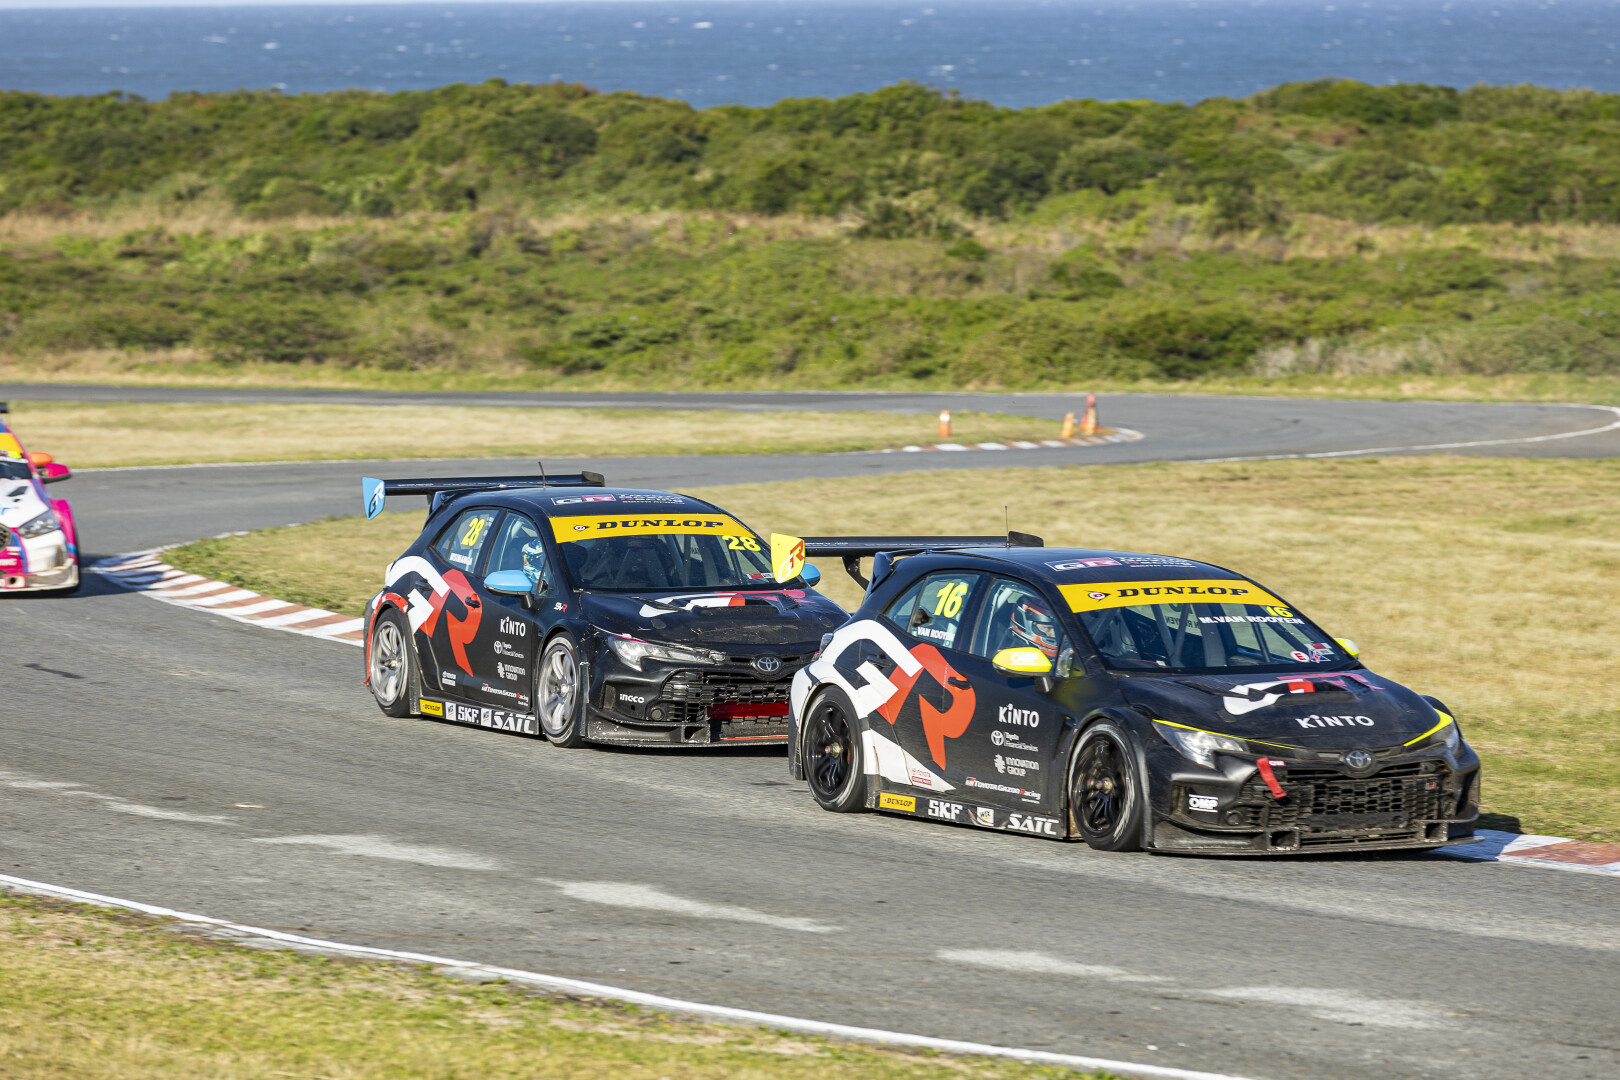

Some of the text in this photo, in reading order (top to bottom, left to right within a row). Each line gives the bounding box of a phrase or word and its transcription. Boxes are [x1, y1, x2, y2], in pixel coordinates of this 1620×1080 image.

[553, 495, 615, 505] GR
[597, 519, 724, 530] DUNLOP
[460, 517, 486, 547] 28
[722, 534, 762, 552] 28
[1053, 560, 1121, 571] GR
[1117, 585, 1249, 598] DUNLOP
[934, 582, 968, 619] 16
[1266, 605, 1294, 618] 16
[1245, 615, 1305, 625] ROOYEN
[917, 626, 931, 637] VAN
[1293, 652, 1307, 661] E
[492, 711, 536, 734] SATC
[974, 780, 998, 790] TOYOTA
[886, 797, 913, 807] DUNLOP
[1188, 797, 1219, 810] OMP
[927, 799, 963, 820] SKF
[1007, 813, 1060, 836] SATC
